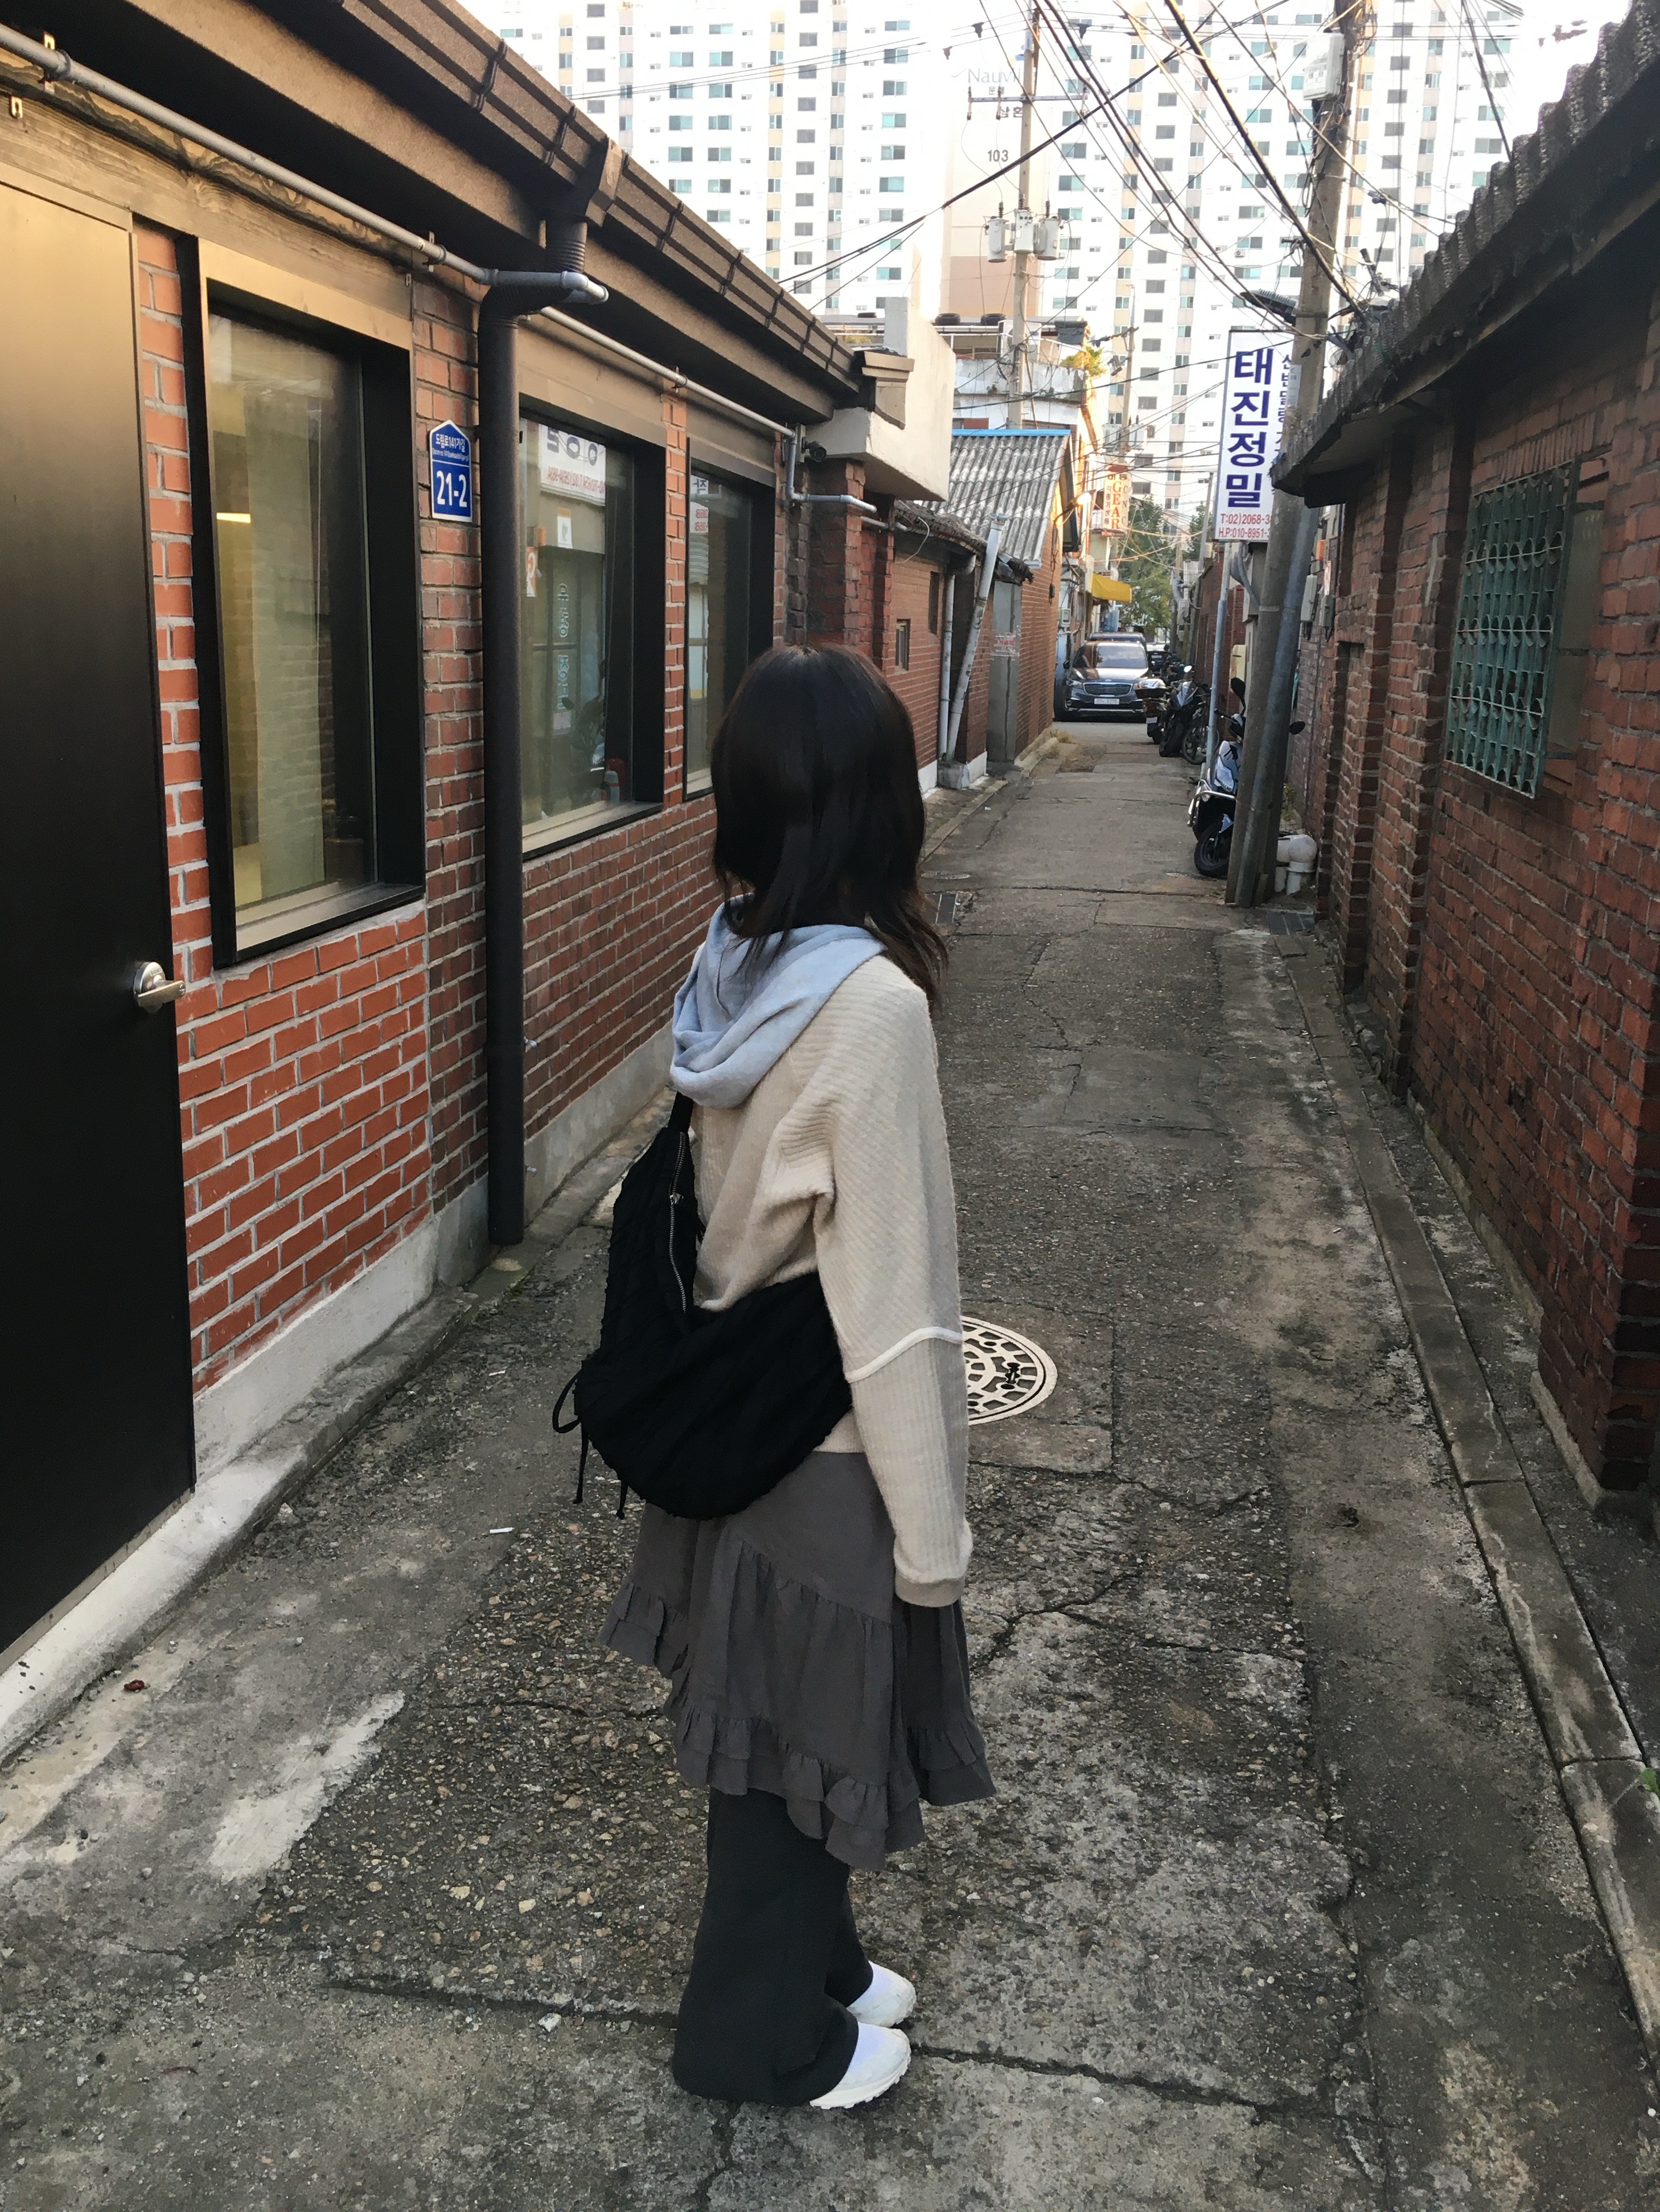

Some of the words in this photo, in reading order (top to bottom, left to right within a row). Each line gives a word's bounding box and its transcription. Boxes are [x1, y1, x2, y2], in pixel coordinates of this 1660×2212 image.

[987, 149, 1009, 162] 103
[435, 433, 465, 453] 도림로141가길
[1225, 348, 1275, 508] 태진정밀
[437, 470, 467, 507] 21-2
[1111, 482, 1121, 529] GEAR
